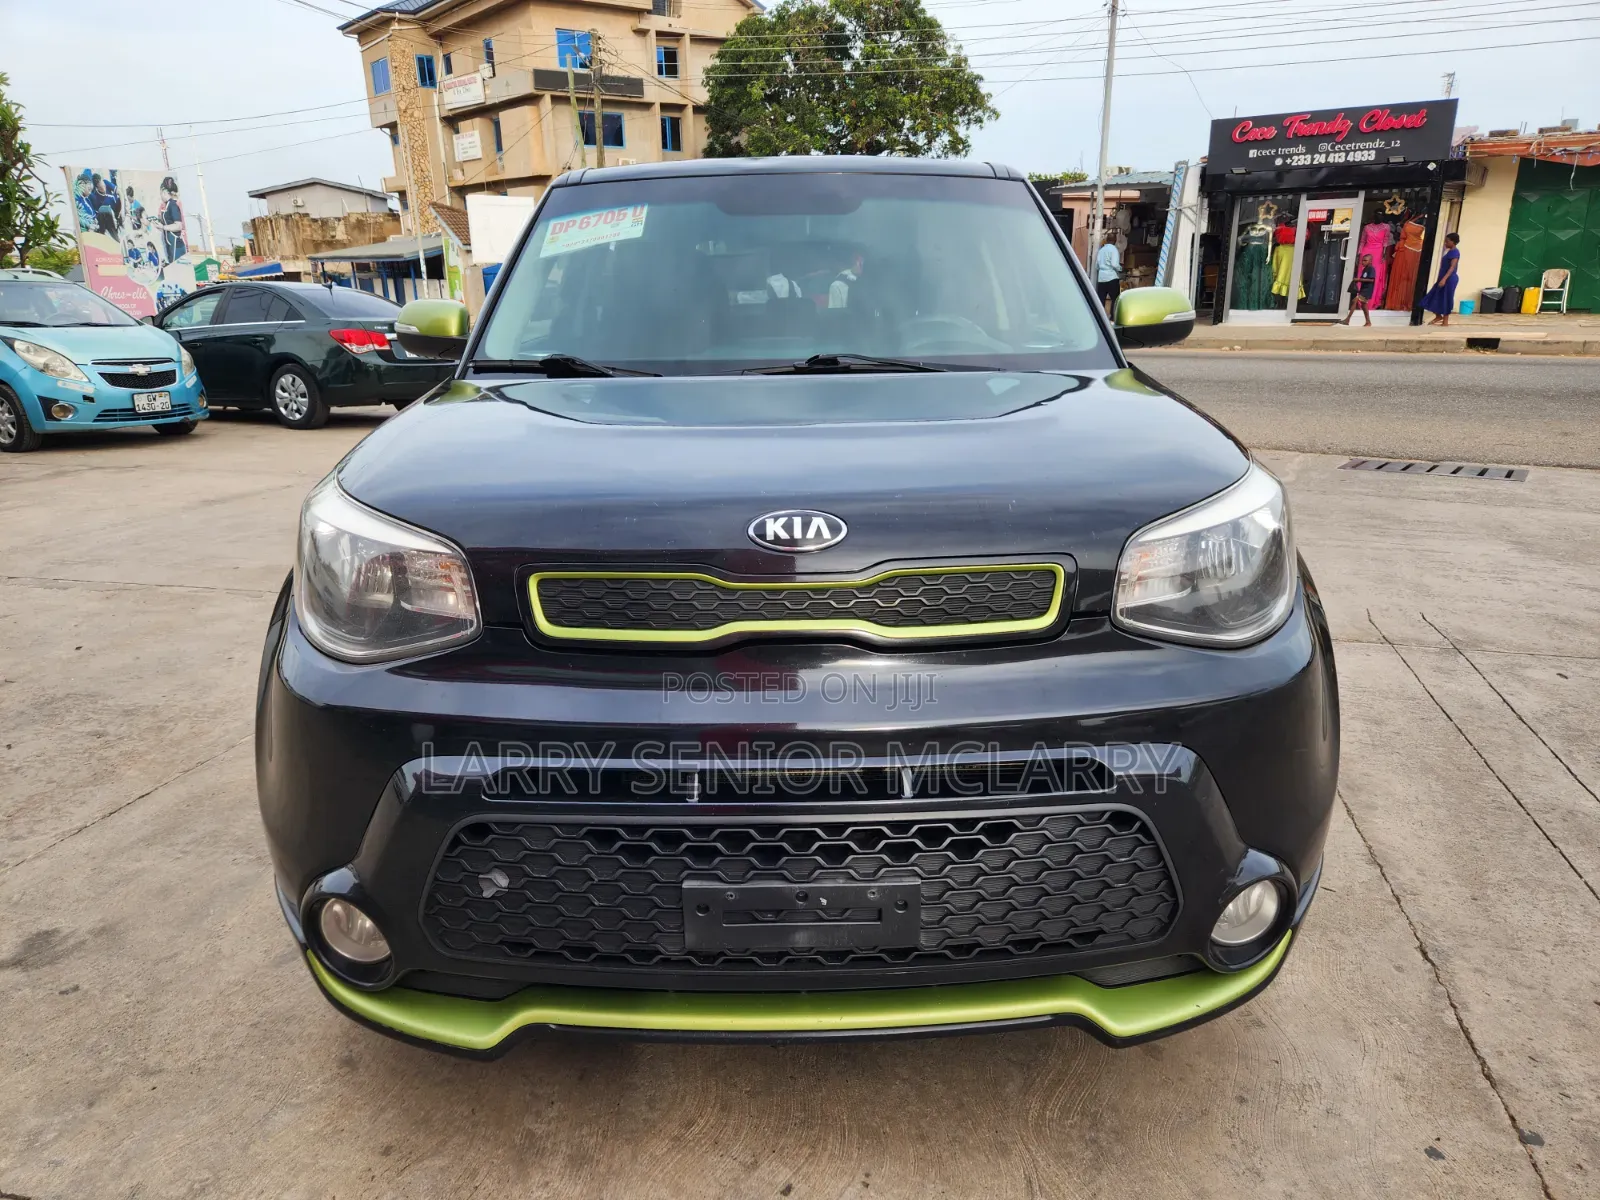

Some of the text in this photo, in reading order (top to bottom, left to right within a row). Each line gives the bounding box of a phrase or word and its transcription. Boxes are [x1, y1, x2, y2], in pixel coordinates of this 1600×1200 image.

[1231, 120, 1278, 143] Cece
[1358, 108, 1428, 133] Closet
[1257, 149, 1277, 157] cece
[1278, 144, 1306, 155] trends
[1285, 149, 1376, 166] +233 24 413 4933
[550, 219, 577, 236] DP
[631, 204, 645, 218] U
[136, 401, 170, 412] 1430-20
[146, 394, 157, 403] GW
[765, 516, 831, 541] KIA
